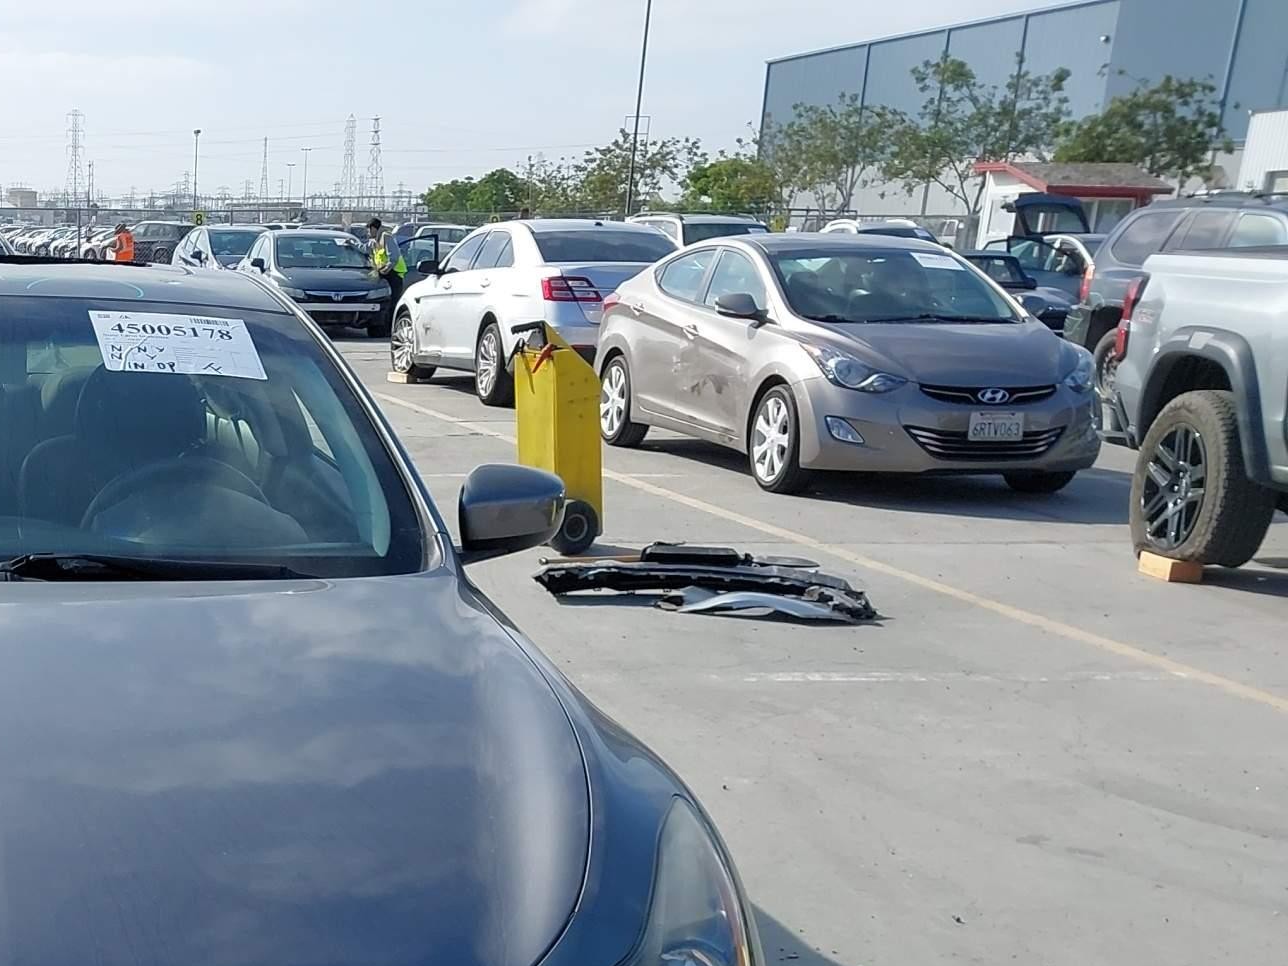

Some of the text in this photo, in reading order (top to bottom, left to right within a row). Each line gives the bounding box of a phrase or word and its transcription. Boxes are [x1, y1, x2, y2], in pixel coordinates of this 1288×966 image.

[196, 214, 203, 225] 8
[111, 322, 233, 341] 45005178
[972, 422, 1021, 436] 6RTV063
